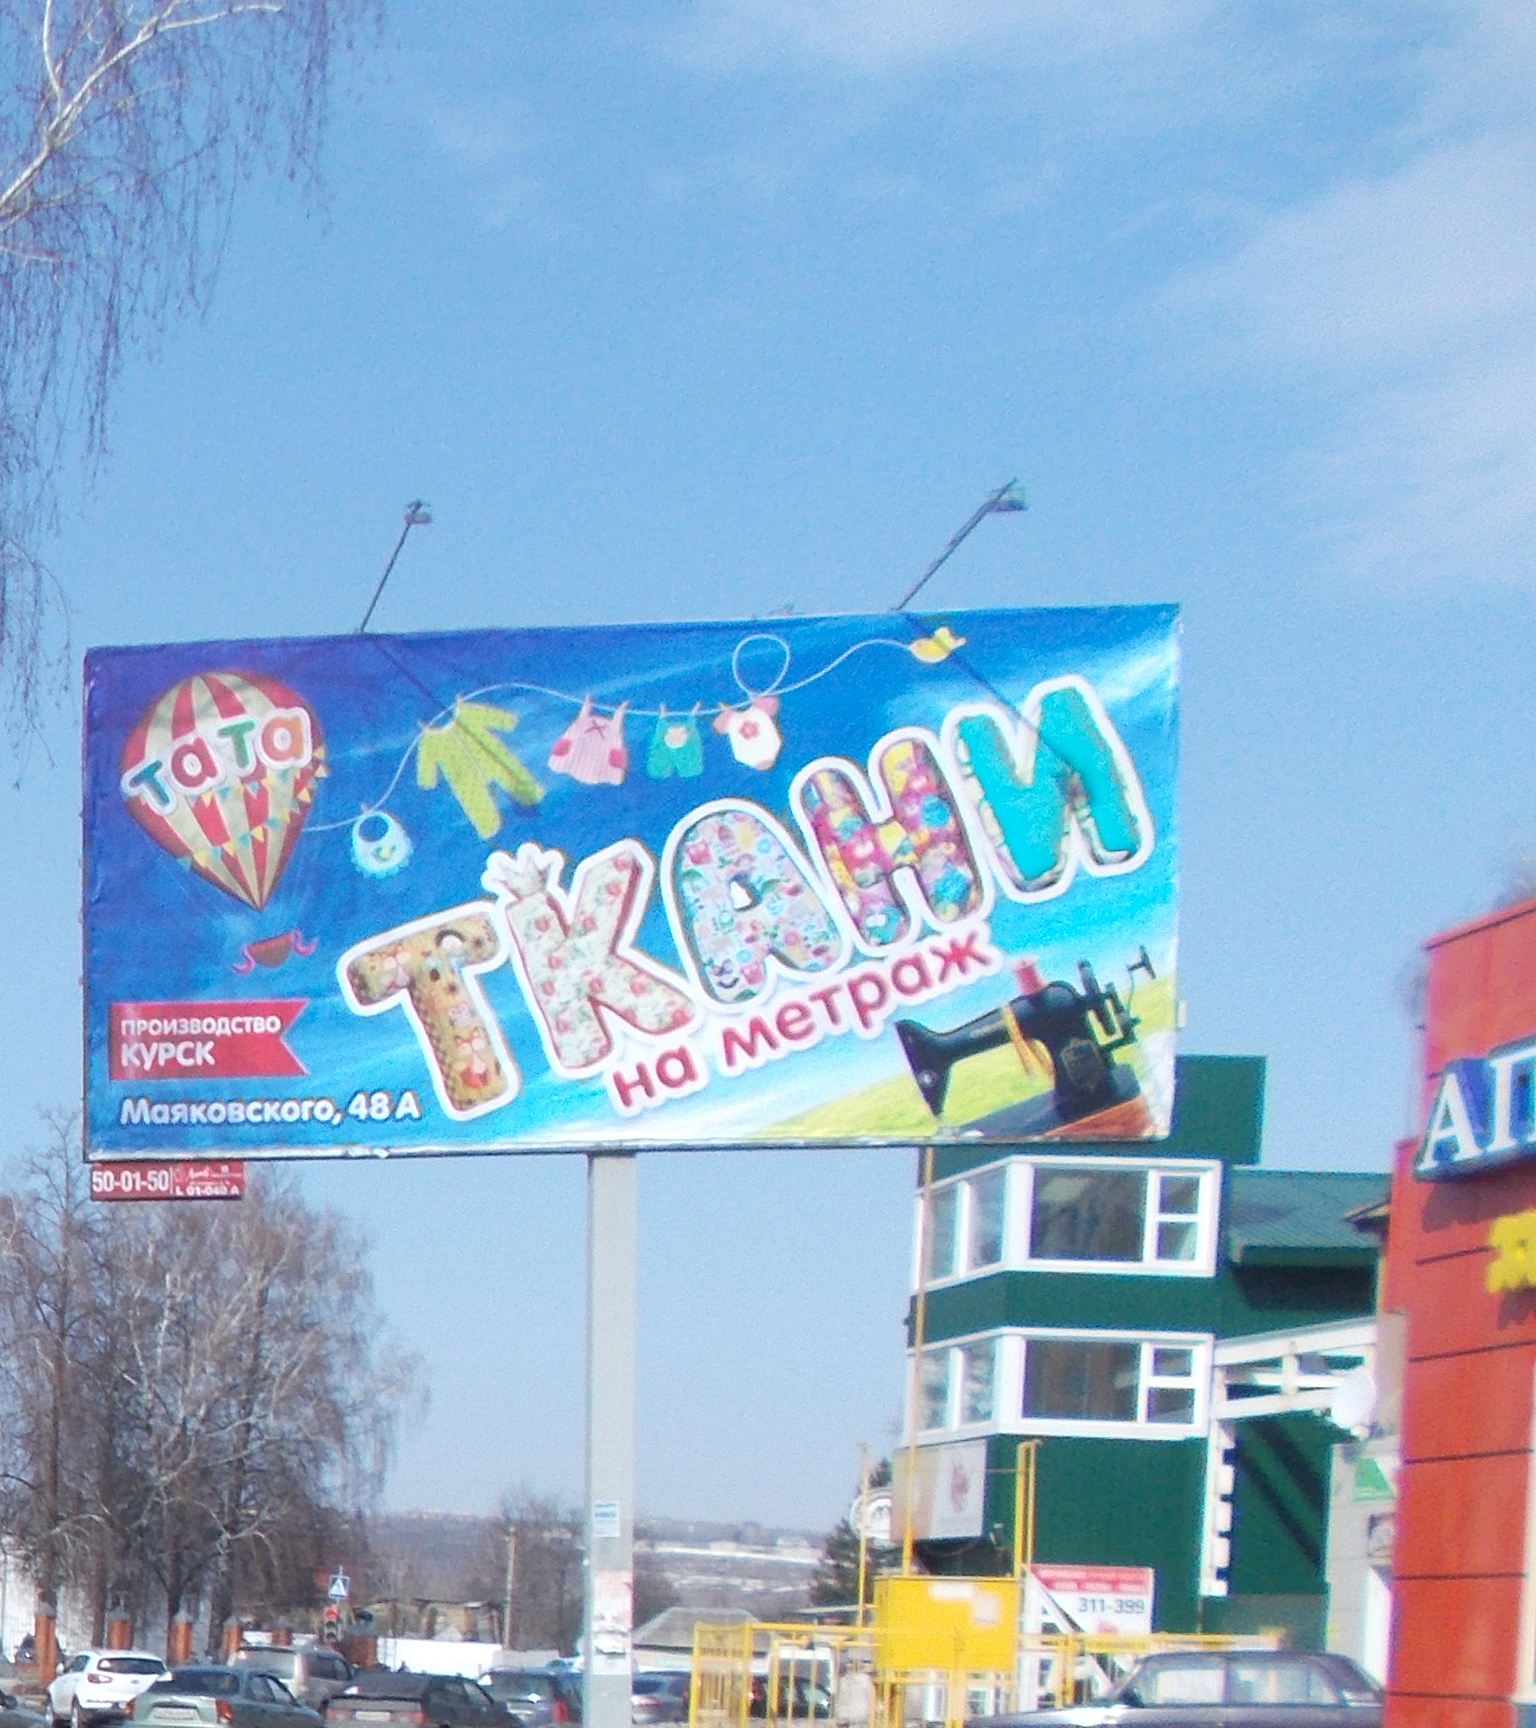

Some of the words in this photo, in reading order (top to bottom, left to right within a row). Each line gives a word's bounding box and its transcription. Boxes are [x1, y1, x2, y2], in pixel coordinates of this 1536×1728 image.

[338, 678, 1150, 1120] ТКАНИ
[120, 1015, 282, 1037] ПРОИЗВОДСТВО
[613, 1043, 698, 1108] на
[722, 931, 990, 1067] метраж
[121, 1040, 216, 1071] КУРСК
[120, 1097, 344, 1126] Маяковского,
[92, 1169, 169, 1193] 50-01-50
[1078, 1597, 1145, 1614] 311-399
